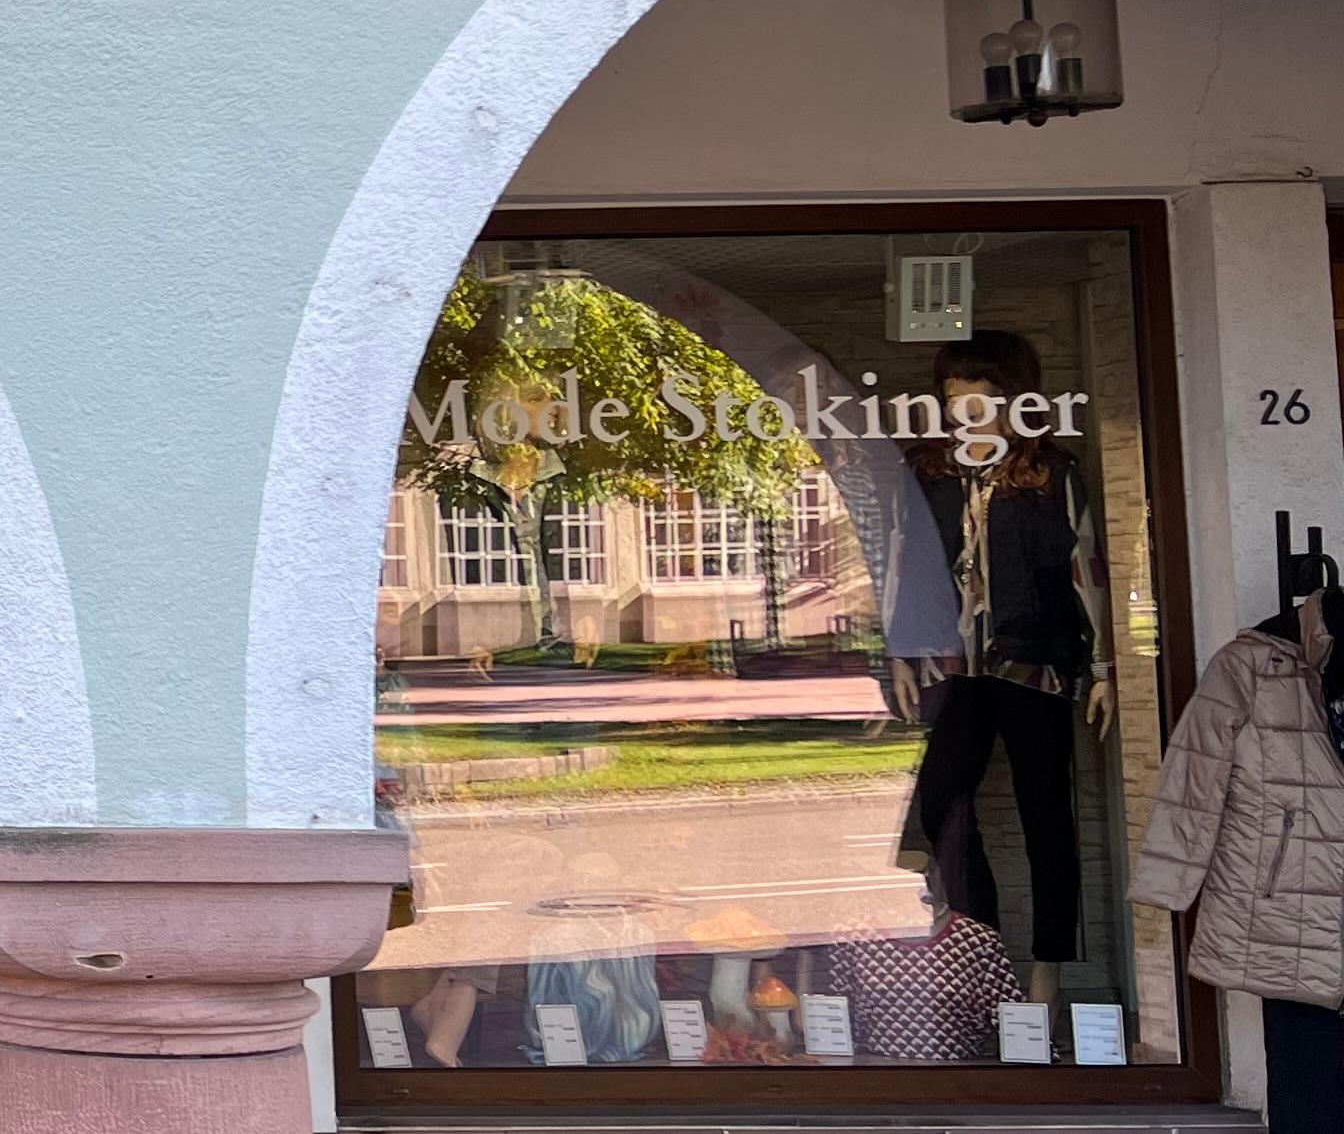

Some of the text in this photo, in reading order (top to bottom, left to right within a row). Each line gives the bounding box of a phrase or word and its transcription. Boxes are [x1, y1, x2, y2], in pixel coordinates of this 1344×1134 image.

[399, 364, 1090, 466] Mode Stokinger
[1259, 388, 1311, 426] 26
